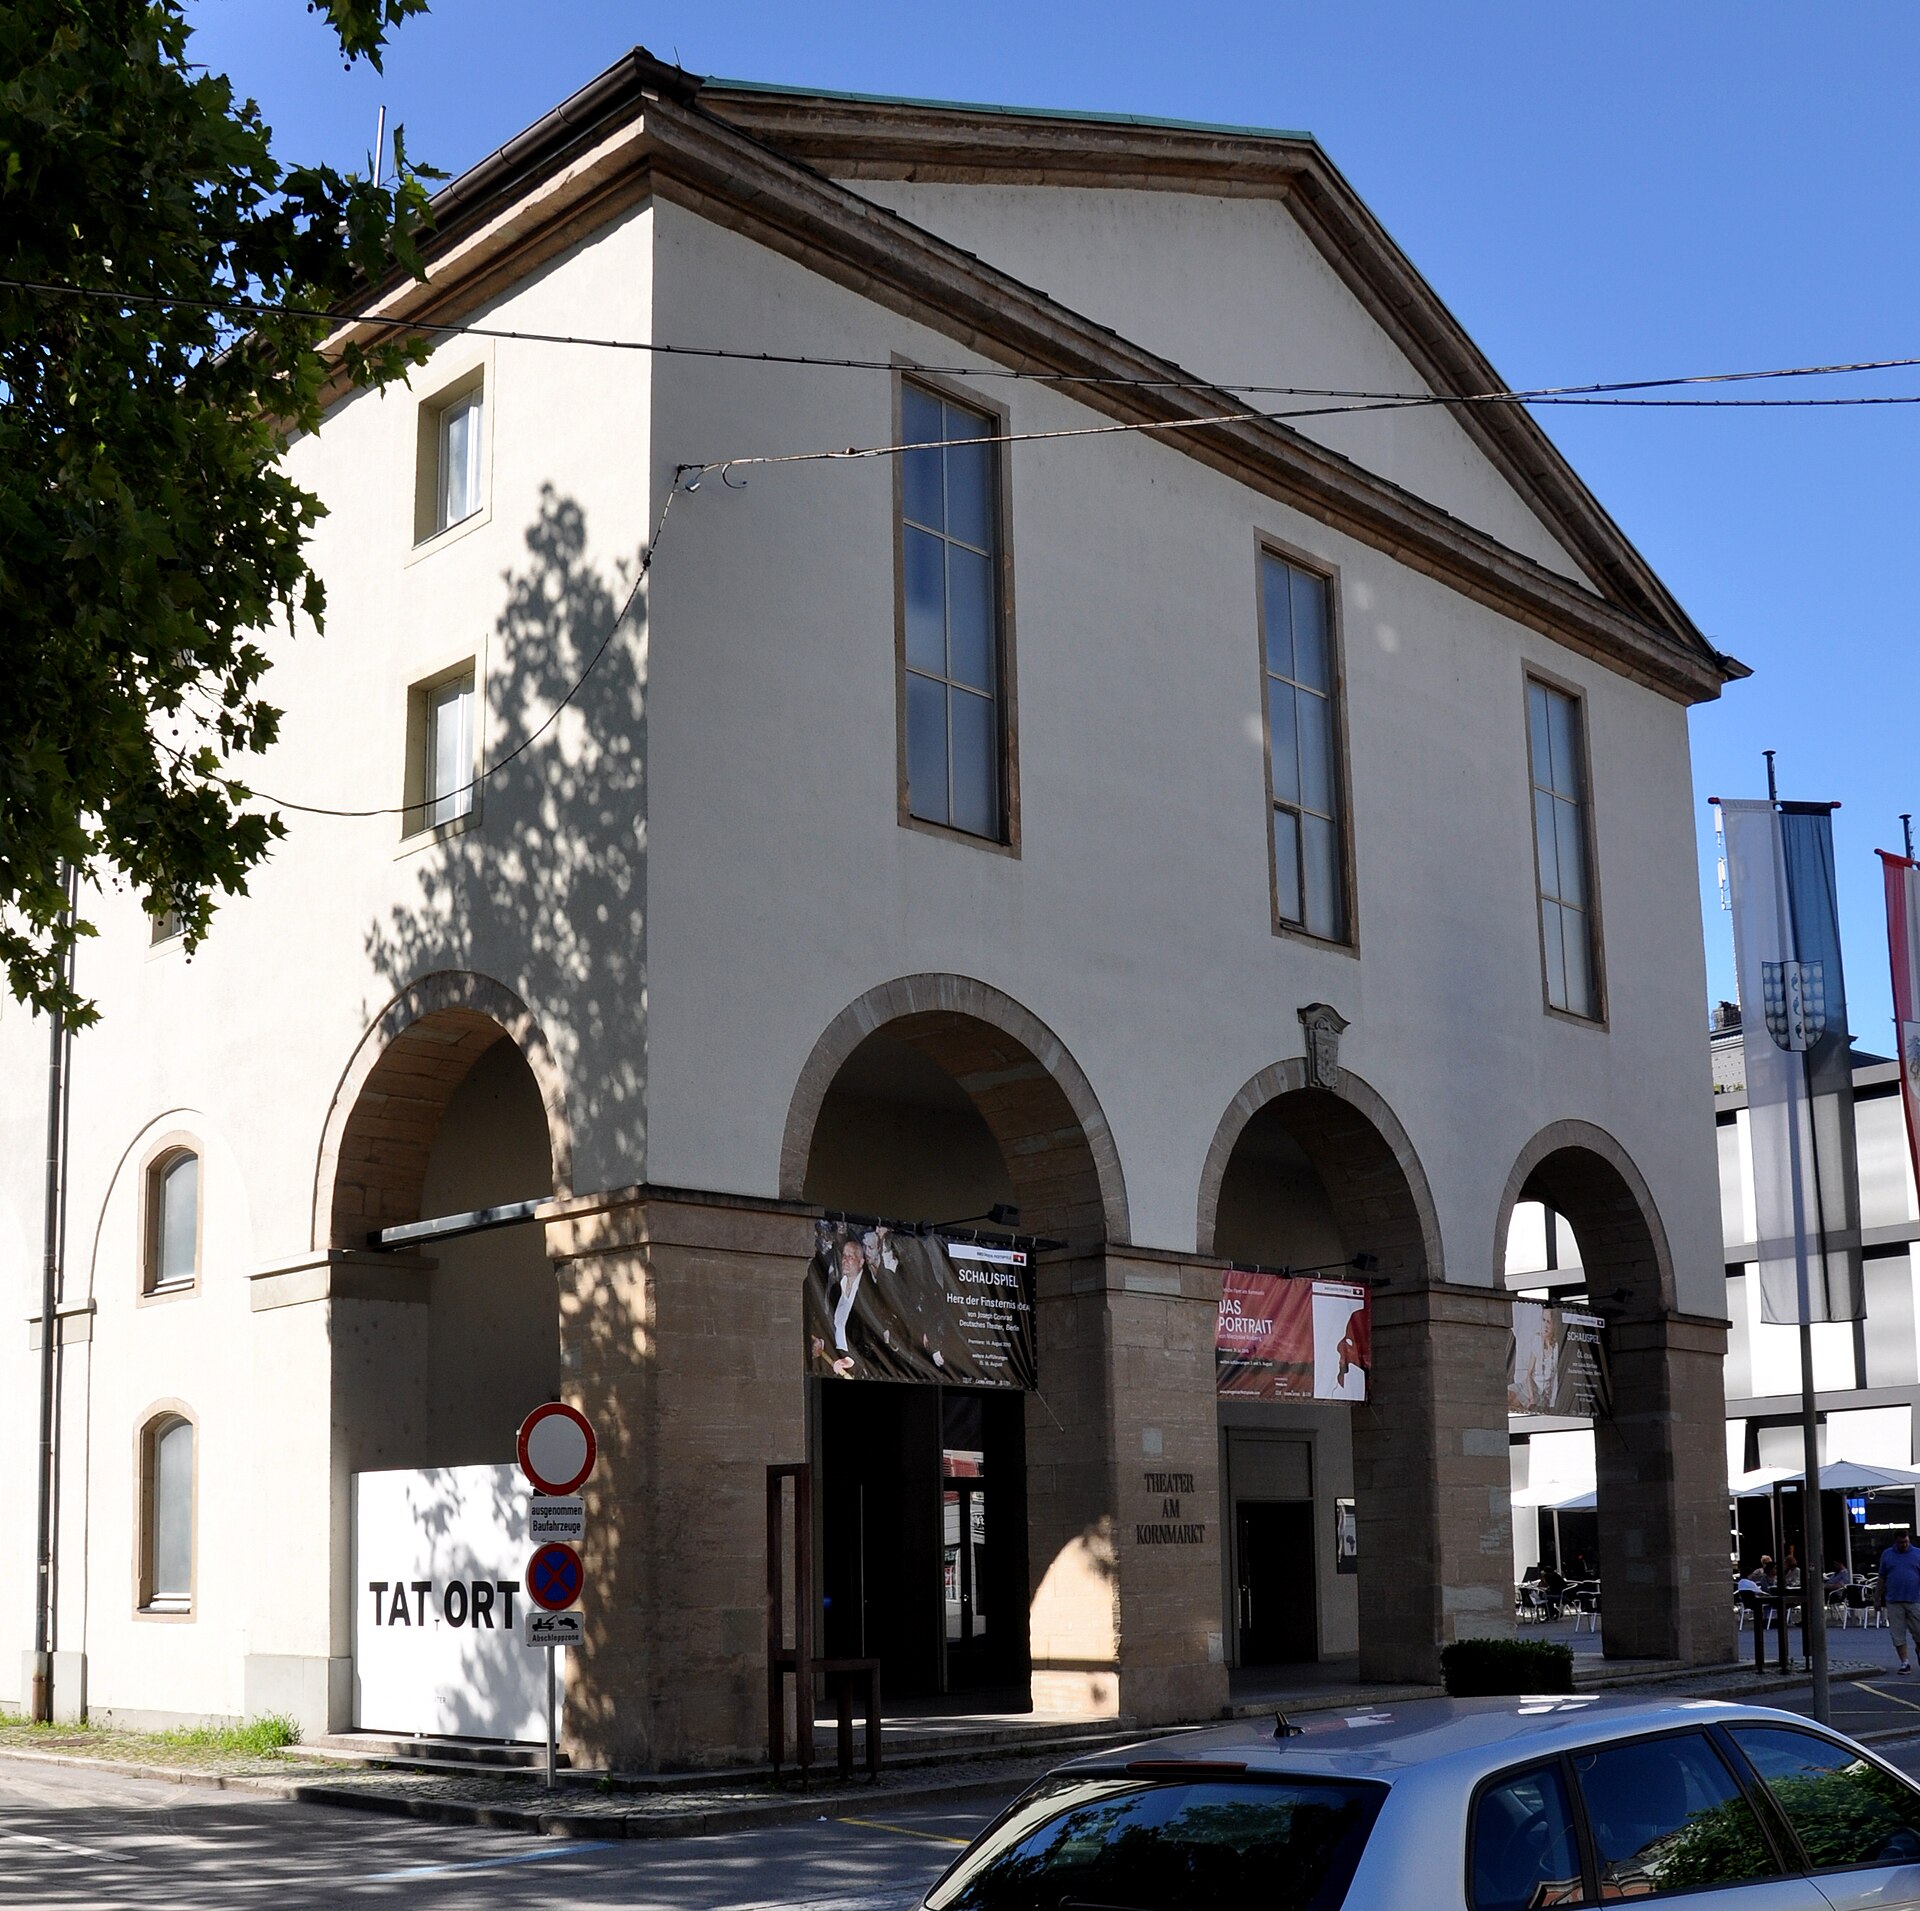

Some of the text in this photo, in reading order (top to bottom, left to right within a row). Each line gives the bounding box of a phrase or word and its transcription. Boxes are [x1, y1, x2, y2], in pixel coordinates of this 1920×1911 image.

[958, 1269, 1019, 1288] SCHAUSPIEL
[946, 1292, 965, 1305] Herz
[965, 1295, 980, 1306] der
[980, 1296, 1016, 1310] Finsternis
[1218, 1299, 1242, 1316] DAS
[1218, 1316, 1273, 1335] PORTRAIT
[1144, 1473, 1195, 1493] THEATER
[531, 1506, 583, 1518] ausgenommen
[1162, 1499, 1181, 1519] AM
[533, 1520, 581, 1534] Baufahrzeuge
[1136, 1524, 1206, 1545] KORNMARKT
[532, 1634, 579, 1643] Abschleppzone
